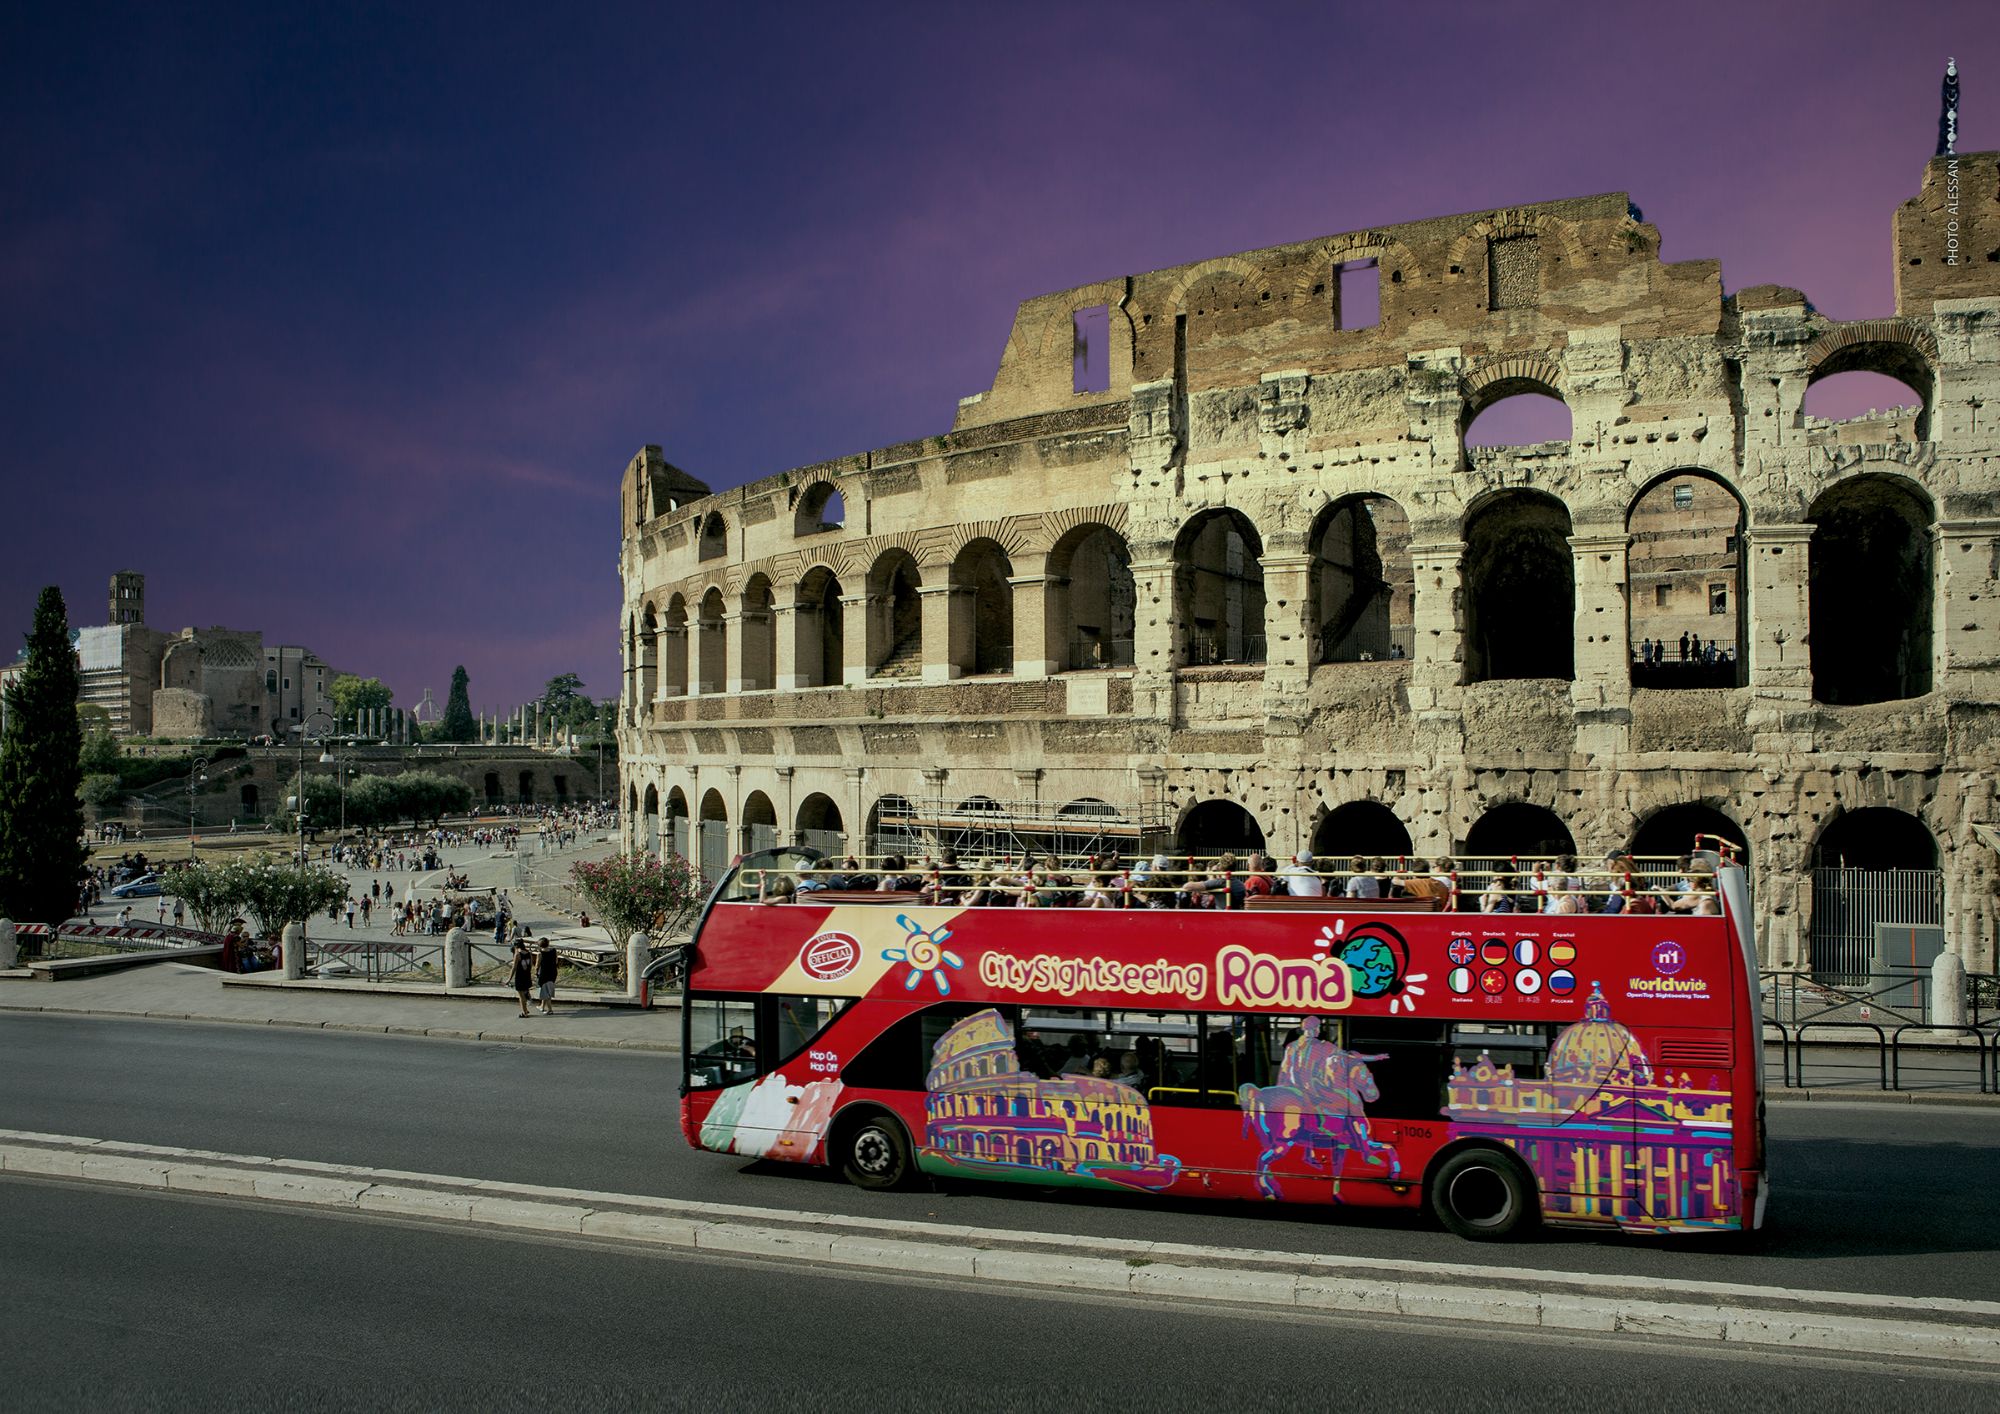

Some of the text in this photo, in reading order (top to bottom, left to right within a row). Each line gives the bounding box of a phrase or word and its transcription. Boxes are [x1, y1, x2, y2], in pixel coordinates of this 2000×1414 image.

[816, 933, 837, 943] TOUR
[581, 951, 600, 962] DRINKS
[810, 947, 851, 966] OFFICIAL
[829, 967, 850, 980] ROMA
[1629, 977, 1707, 992] Worldwide
[809, 1050, 838, 1061] Hop On
[810, 1062, 839, 1072] Hop Off
[1404, 1126, 1433, 1139] 1006
